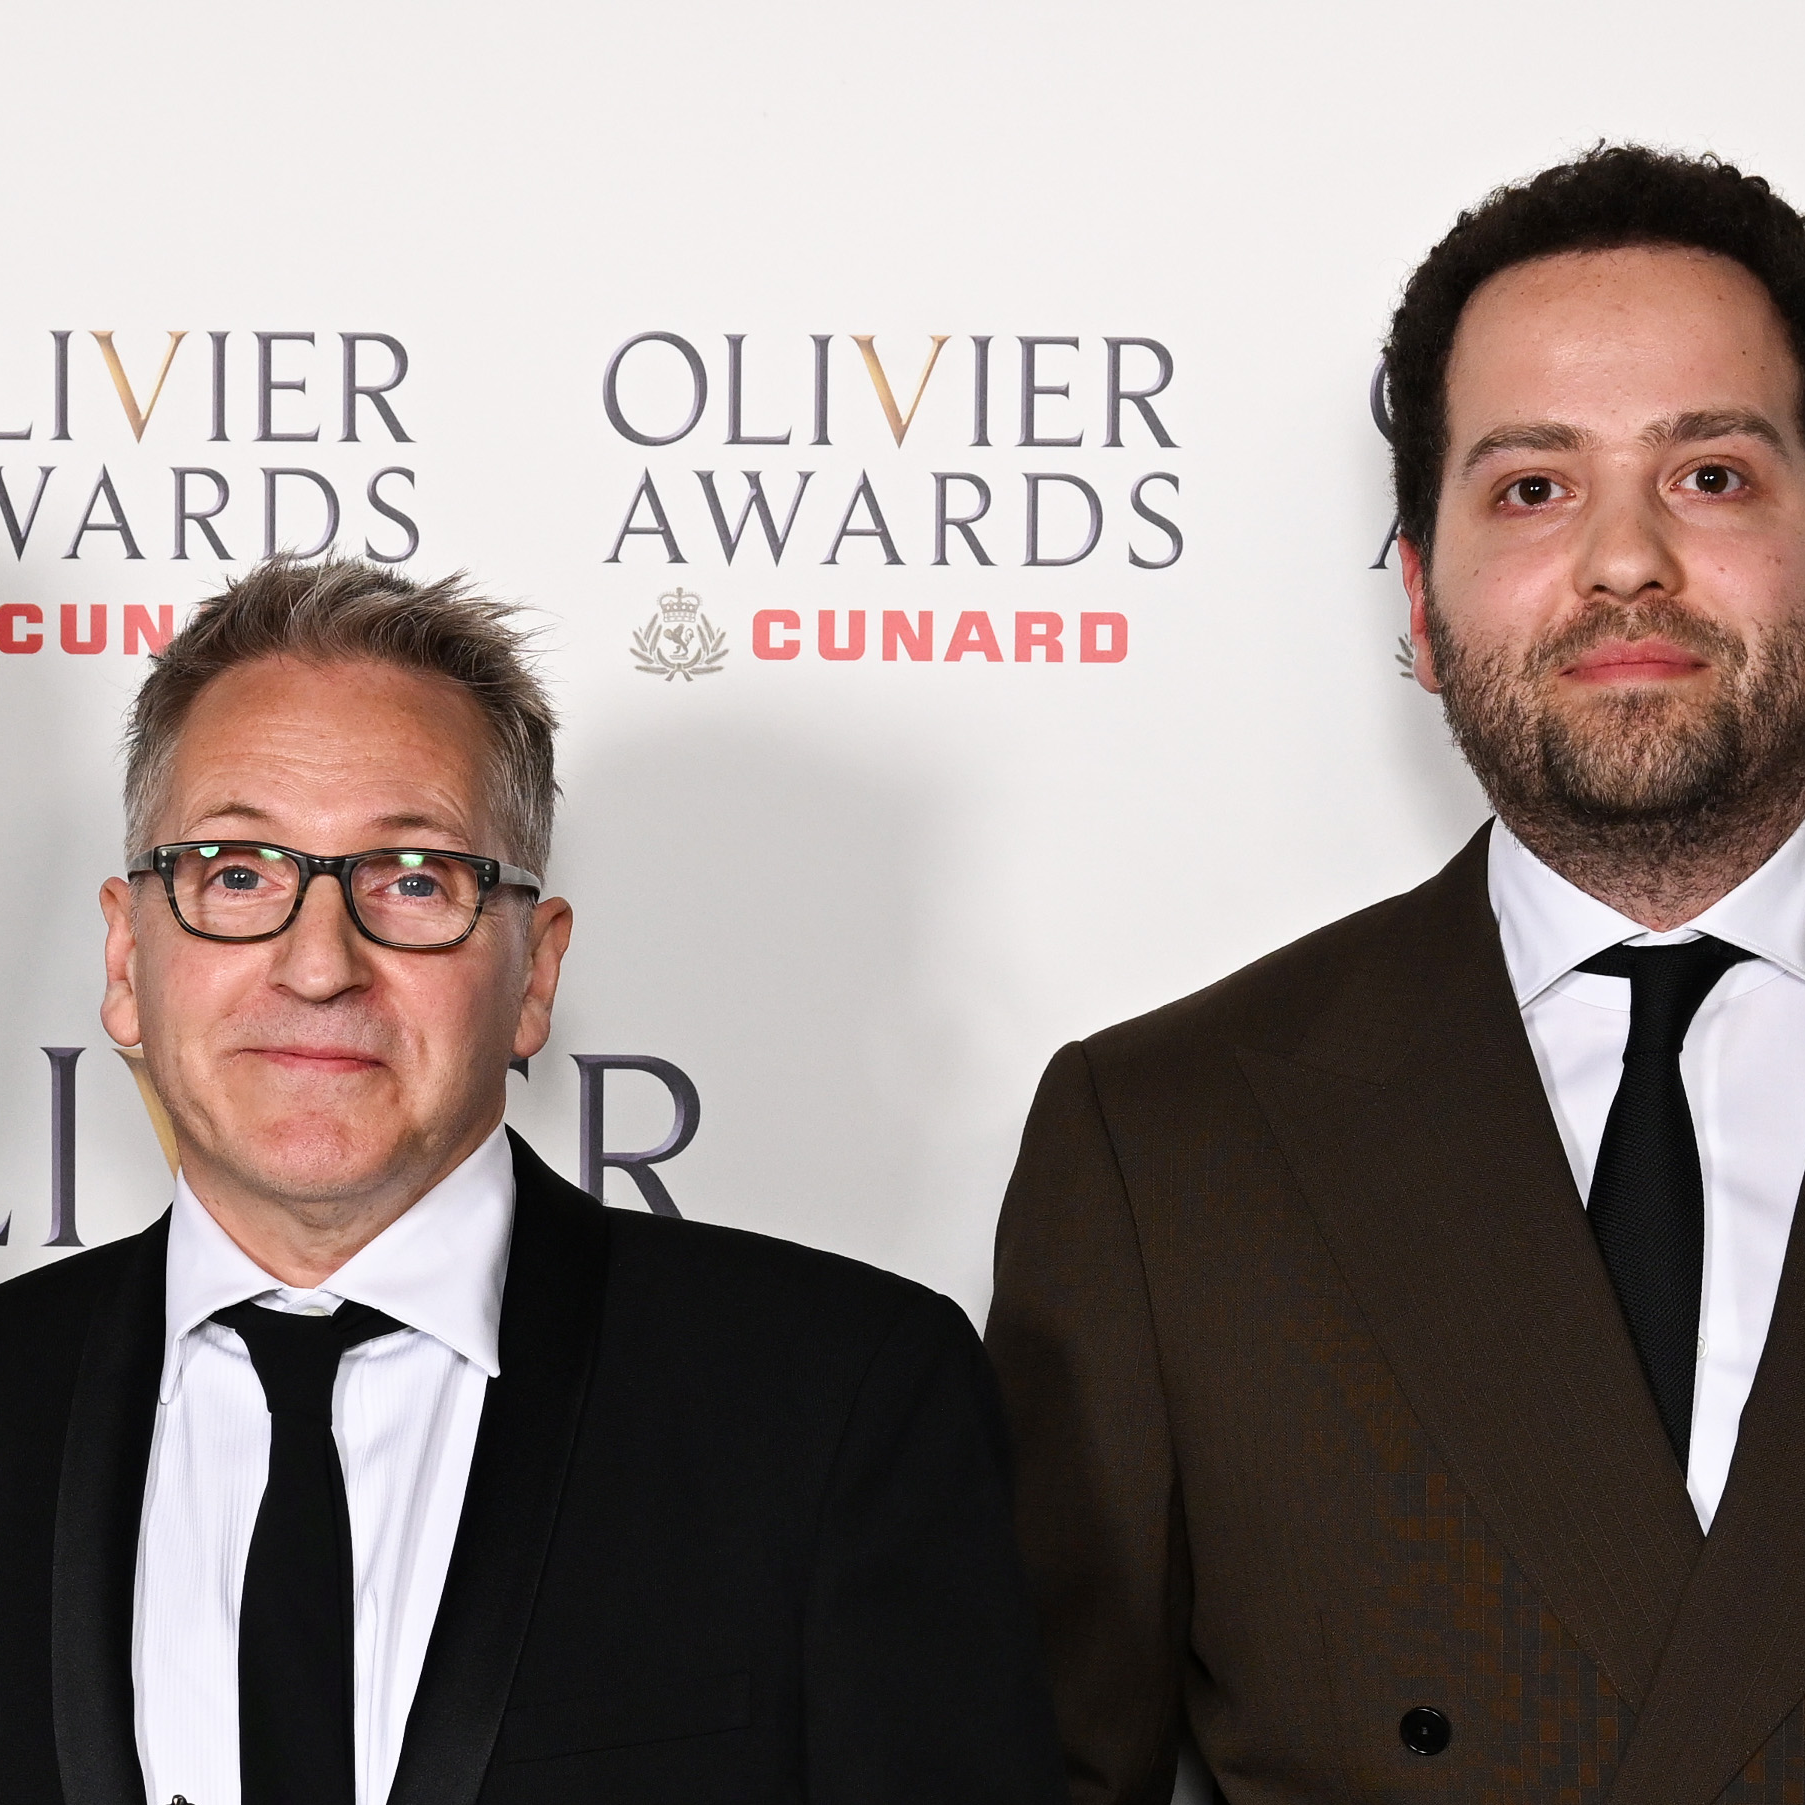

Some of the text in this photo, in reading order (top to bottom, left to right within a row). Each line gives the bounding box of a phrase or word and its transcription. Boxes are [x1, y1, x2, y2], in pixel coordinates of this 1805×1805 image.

[602, 331, 1182, 449] OLIVIER
[602, 466, 1184, 570] AWARDS
[752, 609, 1129, 665] CUNARD
